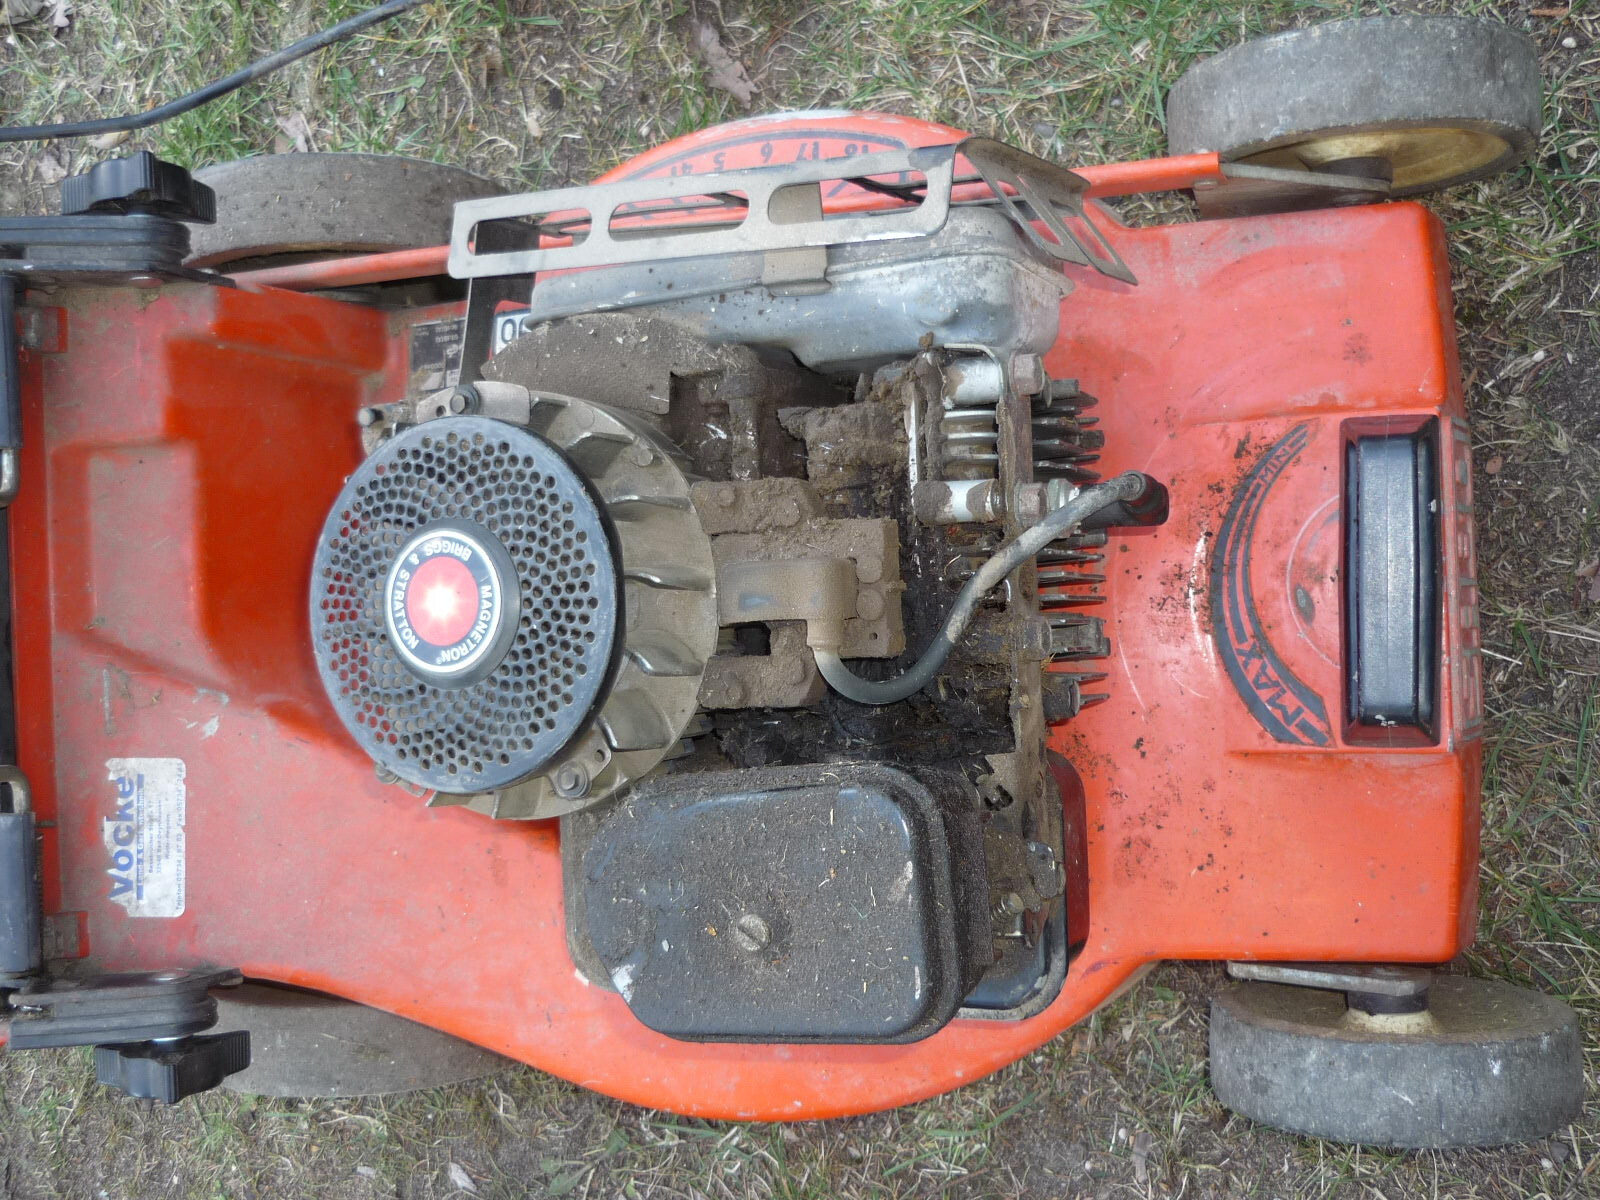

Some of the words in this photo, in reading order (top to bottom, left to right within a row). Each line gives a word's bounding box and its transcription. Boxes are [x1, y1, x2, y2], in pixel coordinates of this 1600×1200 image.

[1257, 446, 1292, 486] MIN
[408, 552, 420, 566] &
[423, 540, 473, 562] BRIGGS
[391, 569, 420, 650] STRATTON
[1235, 646, 1305, 727] MAX
[107, 775, 136, 899] Vocke
